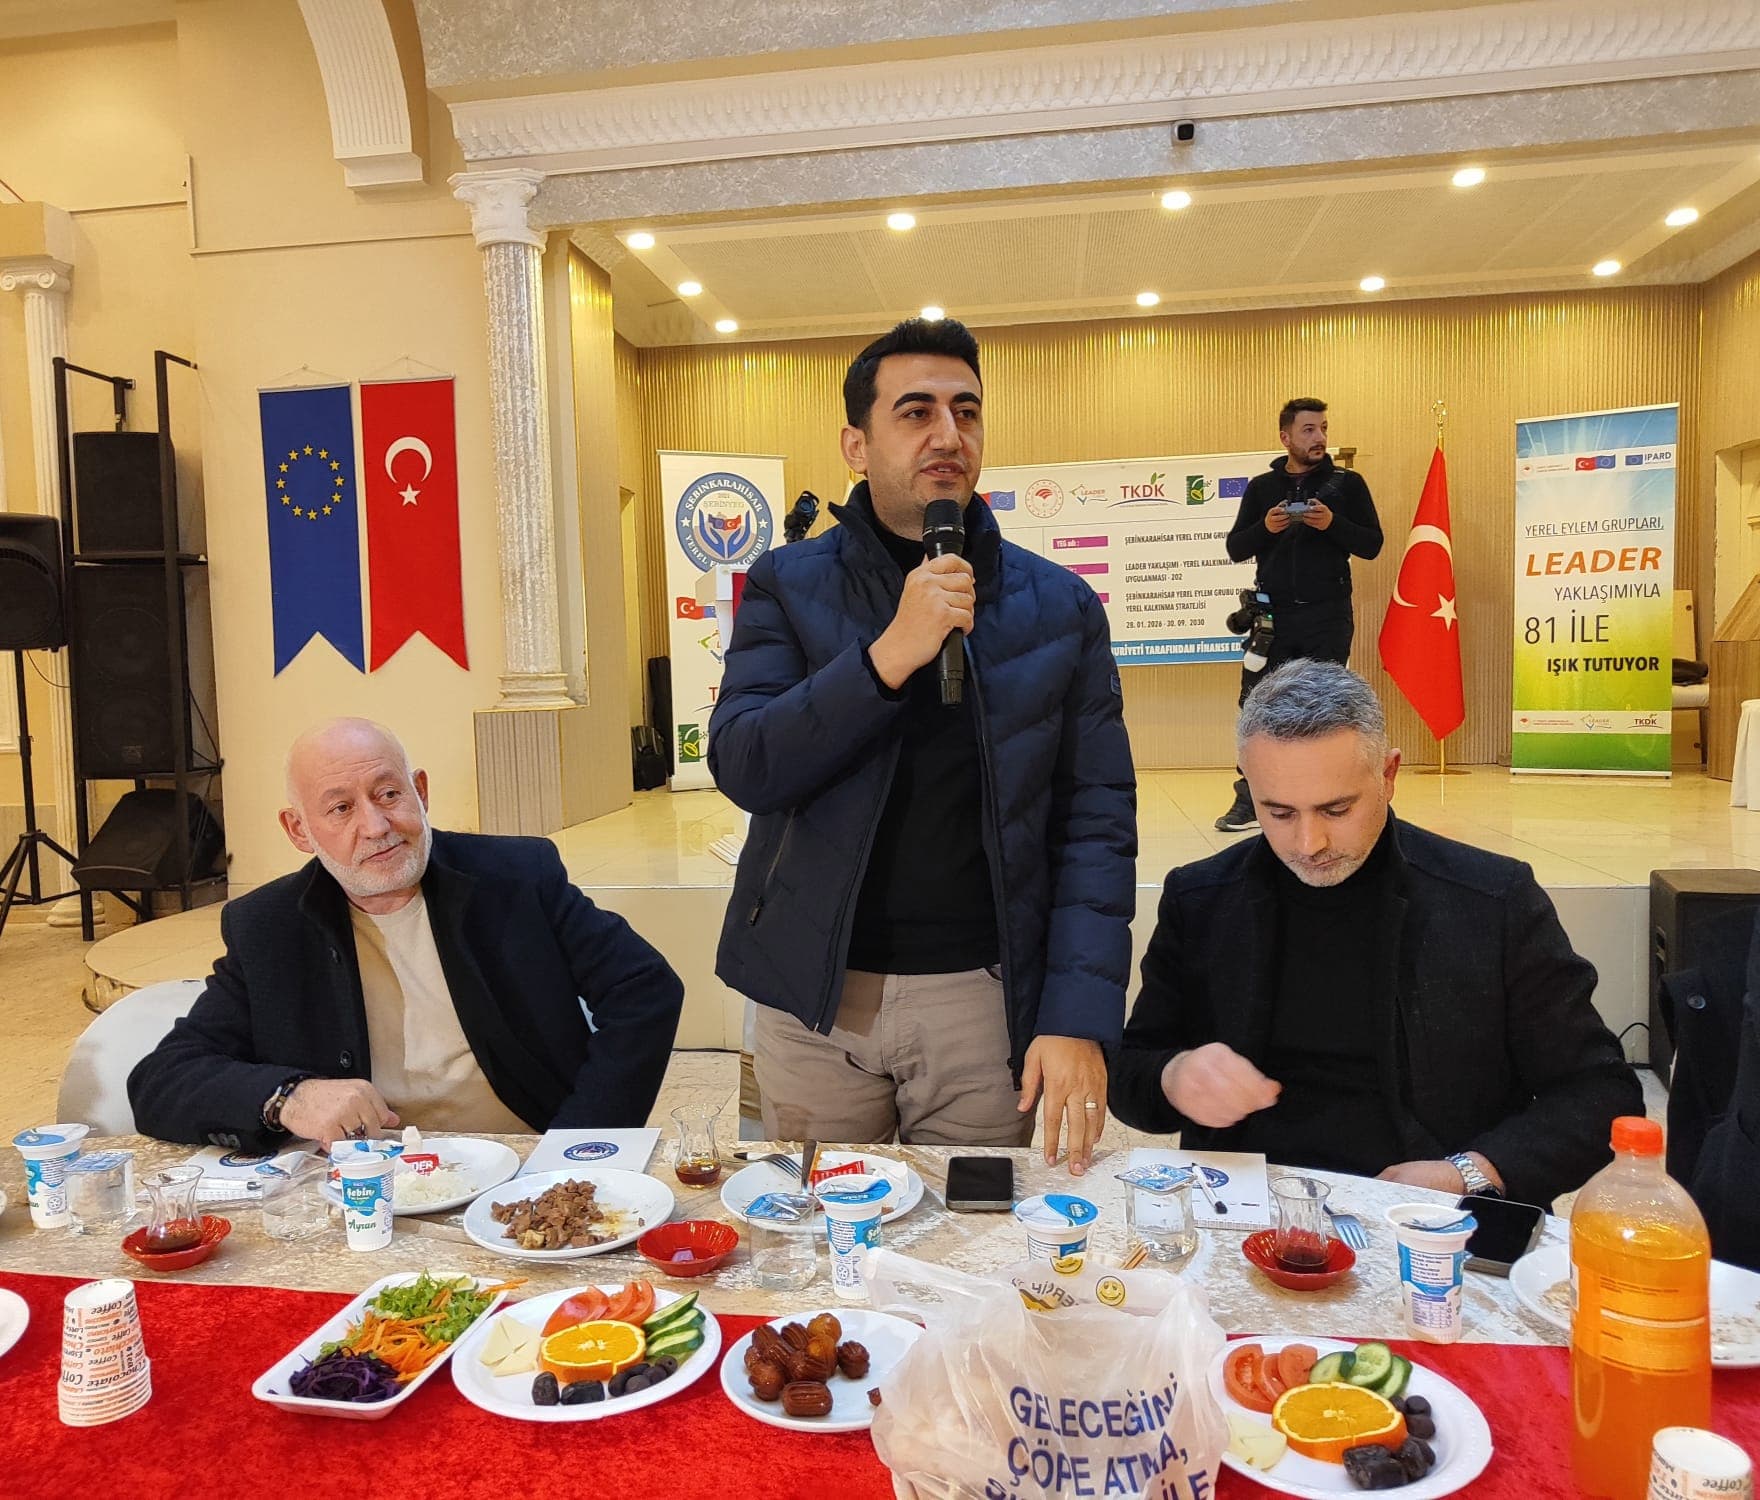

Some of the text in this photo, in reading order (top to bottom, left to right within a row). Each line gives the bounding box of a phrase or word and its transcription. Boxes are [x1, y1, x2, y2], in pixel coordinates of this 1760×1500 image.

[1644, 451, 1672, 462] IPARD
[685, 478, 764, 513] ŞEBİNKARAHİSAR
[1120, 483, 1165, 499] TKDK
[1525, 516, 1664, 537] YEREL EYLEM GRUPLARI,
[1176, 533, 1192, 541] YEREL
[1193, 532, 1212, 540] EYLEM
[685, 534, 765, 566] YEREL GRUBU
[1125, 562, 1147, 571] LEADER
[1148, 561, 1179, 570] YAKLAŞIMI
[1183, 560, 1200, 568] YEREL
[1526, 547, 1662, 576] LEADER
[1125, 574, 1167, 583] UYGULANMASI
[1176, 590, 1193, 598] YEREL
[1194, 589, 1213, 597] EYLEM
[1214, 588, 1234, 596] GRUBU
[1554, 583, 1660, 603] YAKLAŞIMIYLA
[1126, 604, 1143, 613] YEREL
[1144, 602, 1174, 612] KALKINMA
[1525, 609, 1609, 644] 81 İLE
[1145, 644, 1196, 655] TARAFINDAN
[1197, 641, 1230, 653] FİNANSE
[1547, 656, 1660, 676] IŞIK TUTUYOR
[348, 1219, 377, 1232] Ayran
[91, 1301, 122, 1315] Coffee
[88, 1354, 118, 1365] Coffee
[86, 1362, 145, 1387] Chocolate
[1008, 1431, 1188, 1496] ÇÖPE ATMA,
[1702, 1478, 1743, 1492] Coffee
